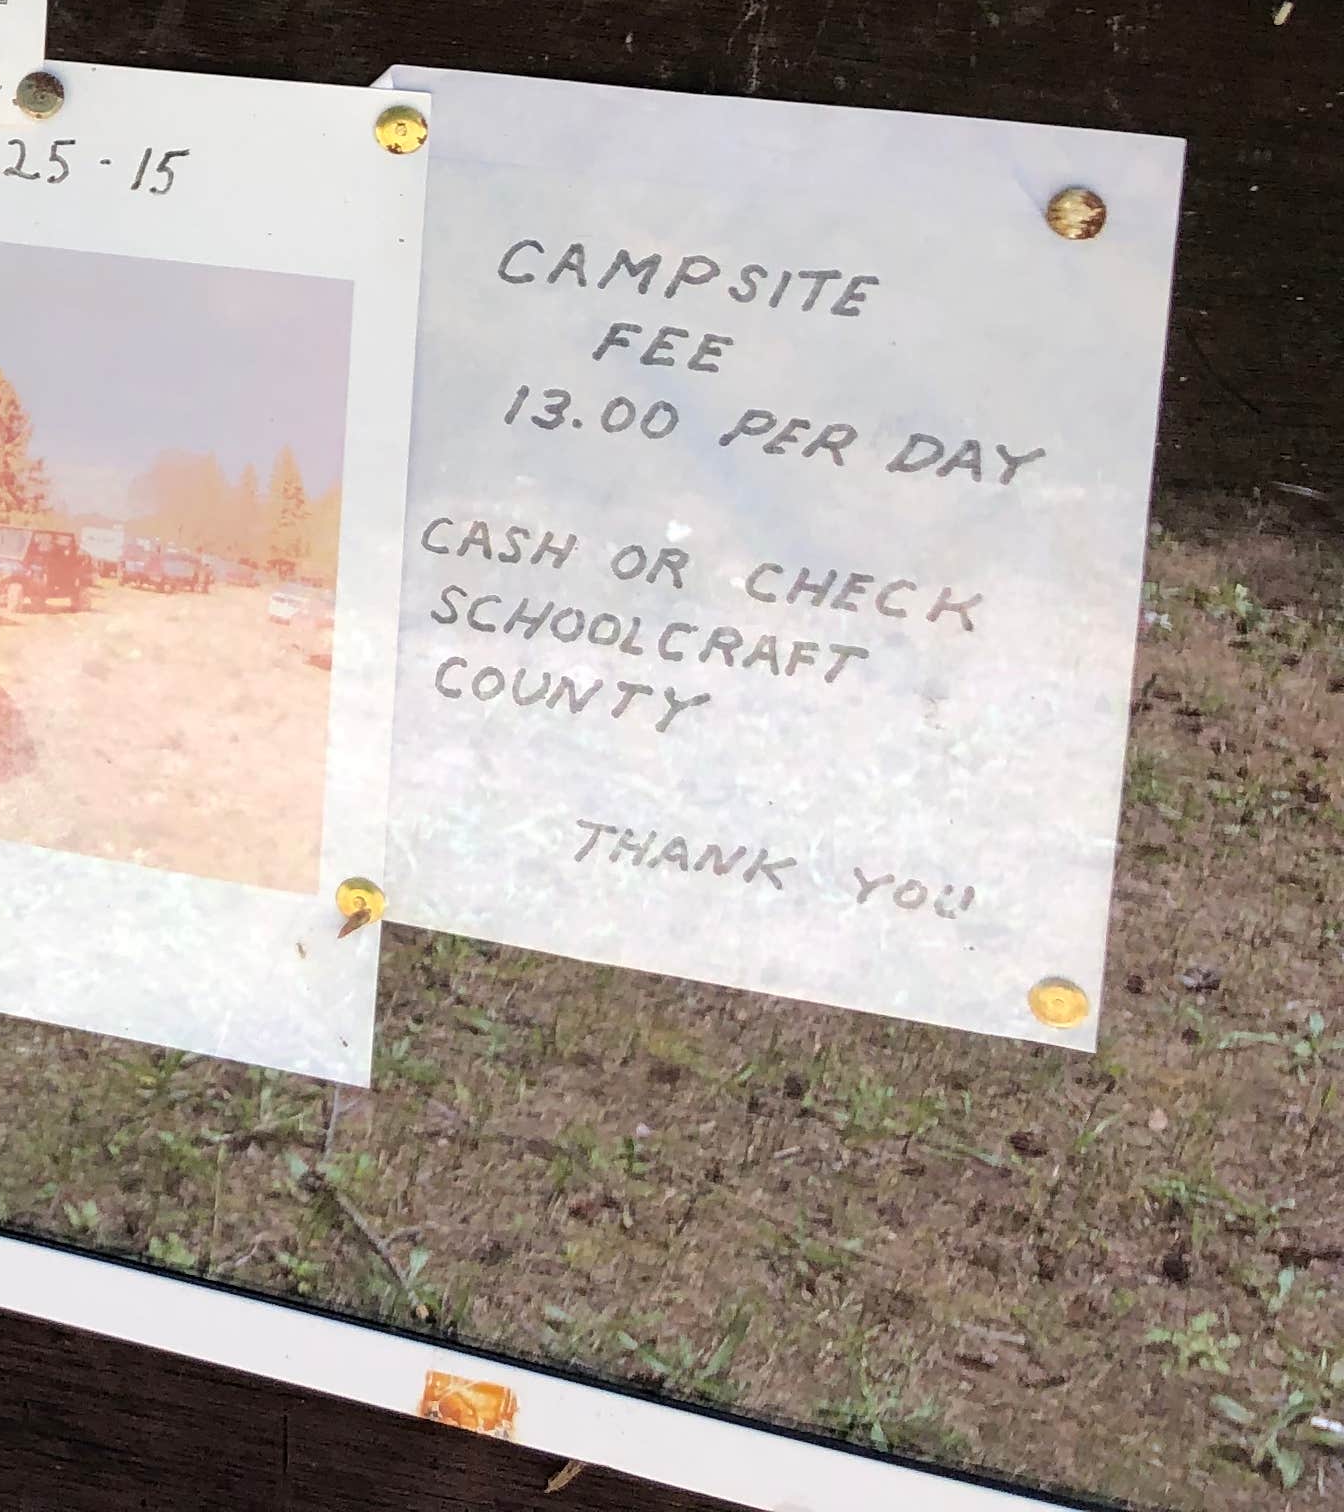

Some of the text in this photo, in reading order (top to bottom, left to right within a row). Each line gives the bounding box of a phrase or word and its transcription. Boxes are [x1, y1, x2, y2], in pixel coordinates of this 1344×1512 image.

[499, 239, 880, 316] CAMPSITE
[593, 323, 734, 372] FEE
[504, 385, 1046, 484] 13.00 PER DAY
[420, 517, 984, 632] CASH OR CHECK
[430, 585, 869, 683] SCHOOLCRAFT
[435, 657, 710, 732] COUNTY
[574, 818, 976, 919] THANK YOU
